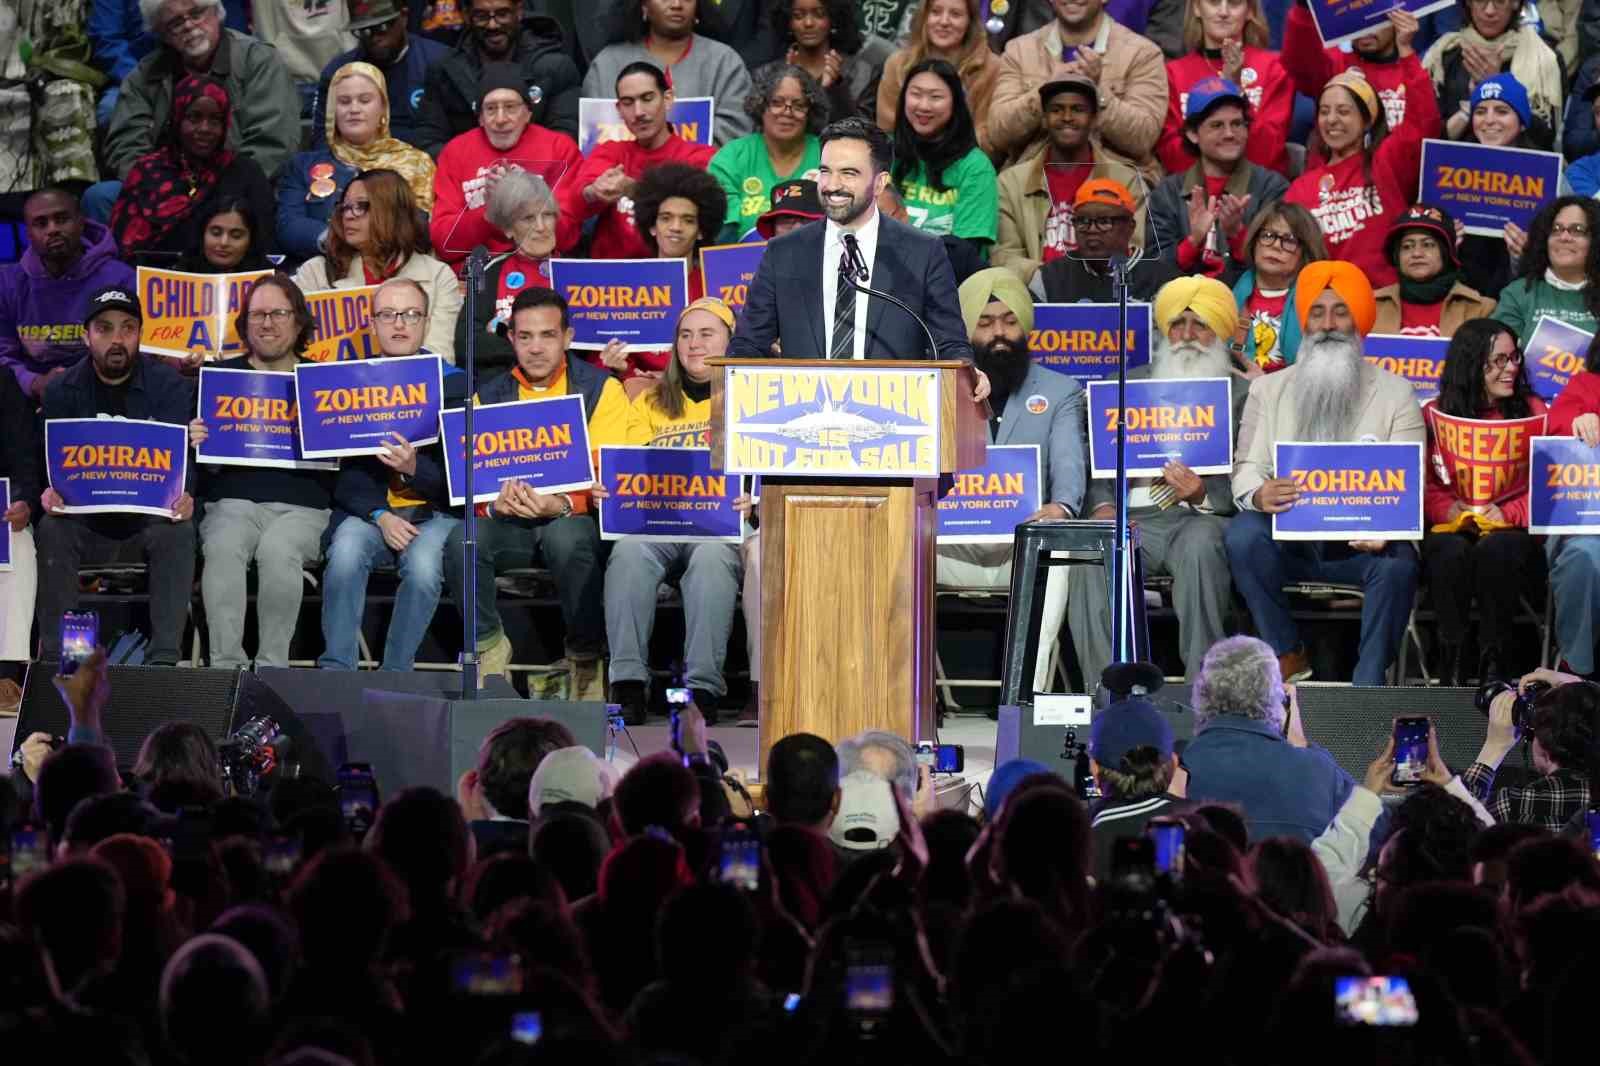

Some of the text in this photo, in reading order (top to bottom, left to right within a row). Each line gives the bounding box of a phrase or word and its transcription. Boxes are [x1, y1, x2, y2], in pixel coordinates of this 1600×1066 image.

[1437, 165, 1544, 198] ZOHRAN
[1456, 193, 1482, 205] NEW
[1484, 196, 1511, 207] YORK
[1513, 199, 1537, 209] CITY
[566, 285, 671, 308] ZOHRAN
[586, 311, 609, 321] NEW
[611, 311, 639, 320] YORK
[641, 310, 666, 320] CITY
[150, 325, 184, 341] FOR
[1027, 329, 1135, 352] ZOHRAN
[1045, 355, 1070, 364] NEW
[1072, 355, 1102, 364] YORK
[1104, 355, 1129, 364] CIT
[314, 383, 428, 412] ZOHRAN
[734, 374, 931, 424] NEW YORK
[338, 413, 364, 424] NEW
[366, 411, 397, 422] YORK
[397, 409, 422, 419] CITY
[1104, 404, 1216, 431] ZOHRAN
[235, 424, 260, 432] NEW
[264, 424, 292, 434] YORK
[818, 429, 849, 447] IS
[1126, 434, 1150, 443] NEW
[1153, 433, 1181, 442] YORK
[1184, 432, 1209, 441] CITY
[1435, 420, 1525, 461] FREEZE
[63, 445, 172, 471] ZOHRAN
[485, 457, 510, 468] NEW
[513, 453, 542, 464] YORK
[543, 450, 568, 461] CITY
[734, 433, 932, 470] NOT FOR SALE
[82, 471, 107, 480] NEW
[110, 471, 140, 481] YORK
[141, 473, 166, 483] CITY
[616, 473, 726, 498] ZOHRAN
[1290, 469, 1406, 492] ZOHRAN
[636, 501, 662, 510] NEW
[663, 501, 693, 510] YORK
[696, 501, 720, 511] CITY
[960, 500, 992, 509] YORK
[992, 499, 1018, 509] CITY
[1312, 497, 1339, 505] NEW
[1342, 496, 1372, 505] YORK
[1374, 496, 1399, 505] CITY
